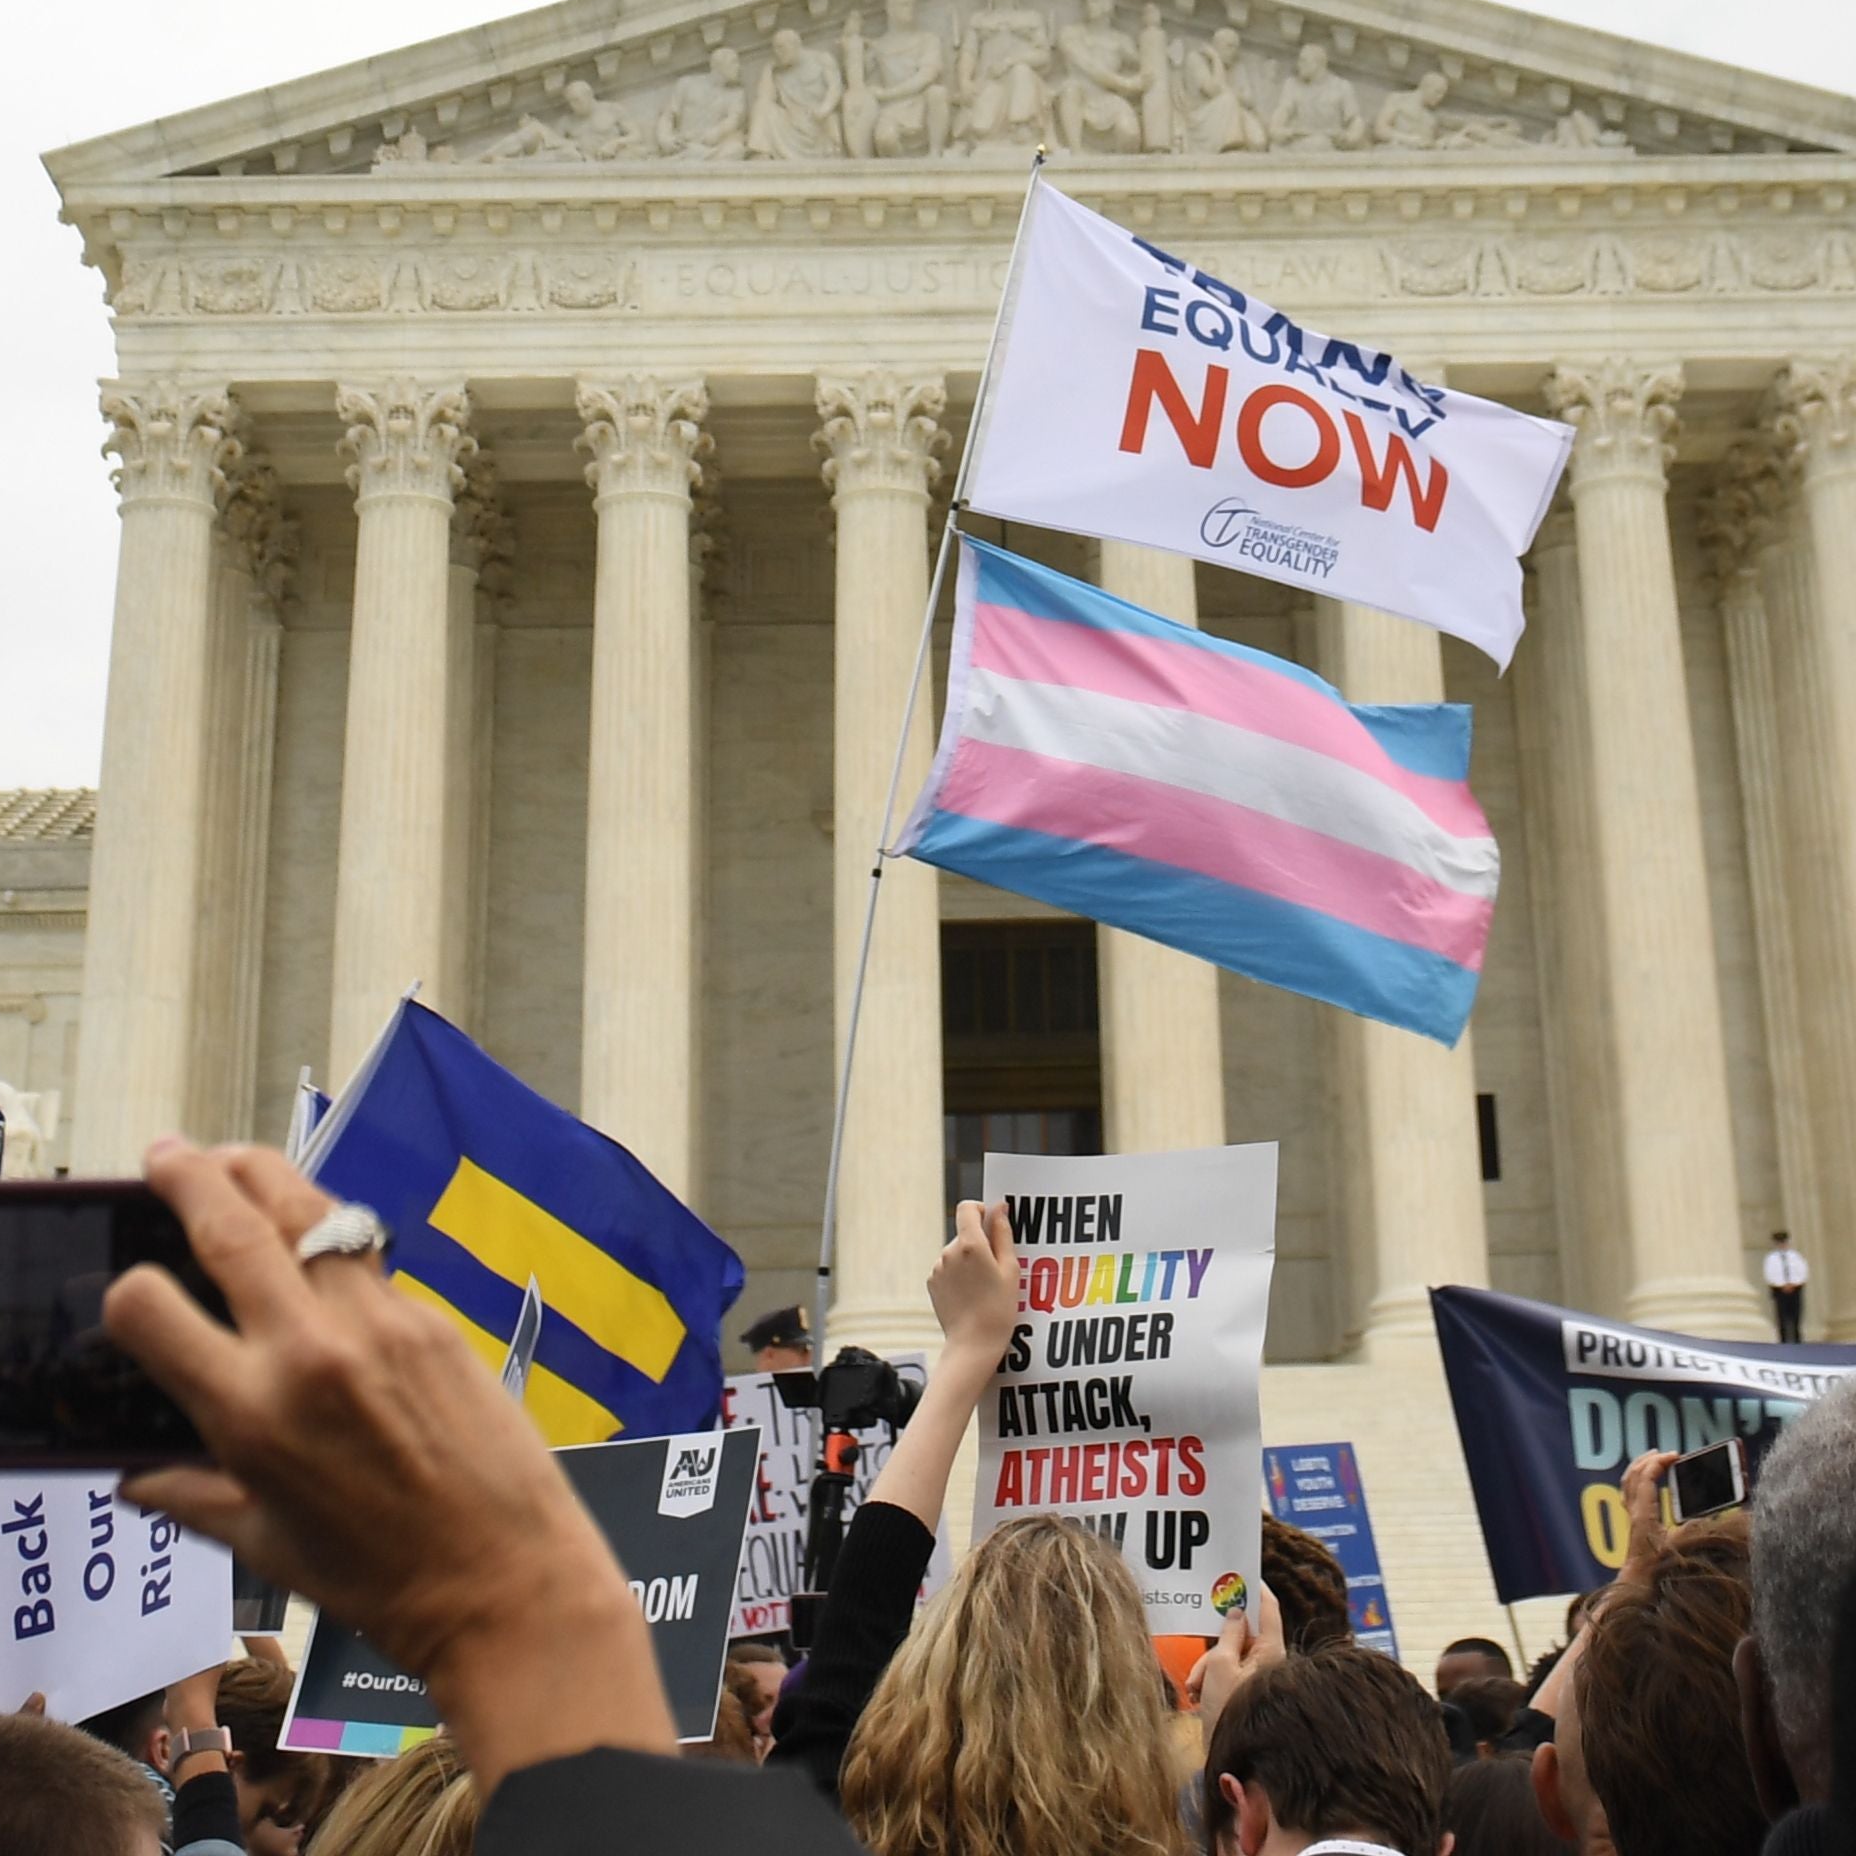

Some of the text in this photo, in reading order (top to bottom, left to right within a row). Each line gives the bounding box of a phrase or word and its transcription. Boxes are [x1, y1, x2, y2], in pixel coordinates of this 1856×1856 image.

[852, 258, 1010, 296] JUSTIC
[1252, 255, 1341, 288] LAW
[1118, 347, 1448, 533] NOW
[1238, 538, 1336, 579] EQUALITY
[1244, 525, 1340, 562] TRANSGENDER
[1005, 1194, 1123, 1245] WHEN
[1046, 1312, 1174, 1369] UNDER
[998, 1375, 1151, 1438] ATTACK,
[665, 1484, 711, 1499] UNITED
[667, 1478, 712, 1488] AMERICANS
[994, 1435, 1207, 1508] ATHEISTS
[1, 1491, 56, 1641] Back
[83, 1489, 116, 1602] Our
[140, 1506, 182, 1617] Rig
[1145, 1510, 1209, 1571] UP
[1142, 1590, 1203, 1609] ists.org
